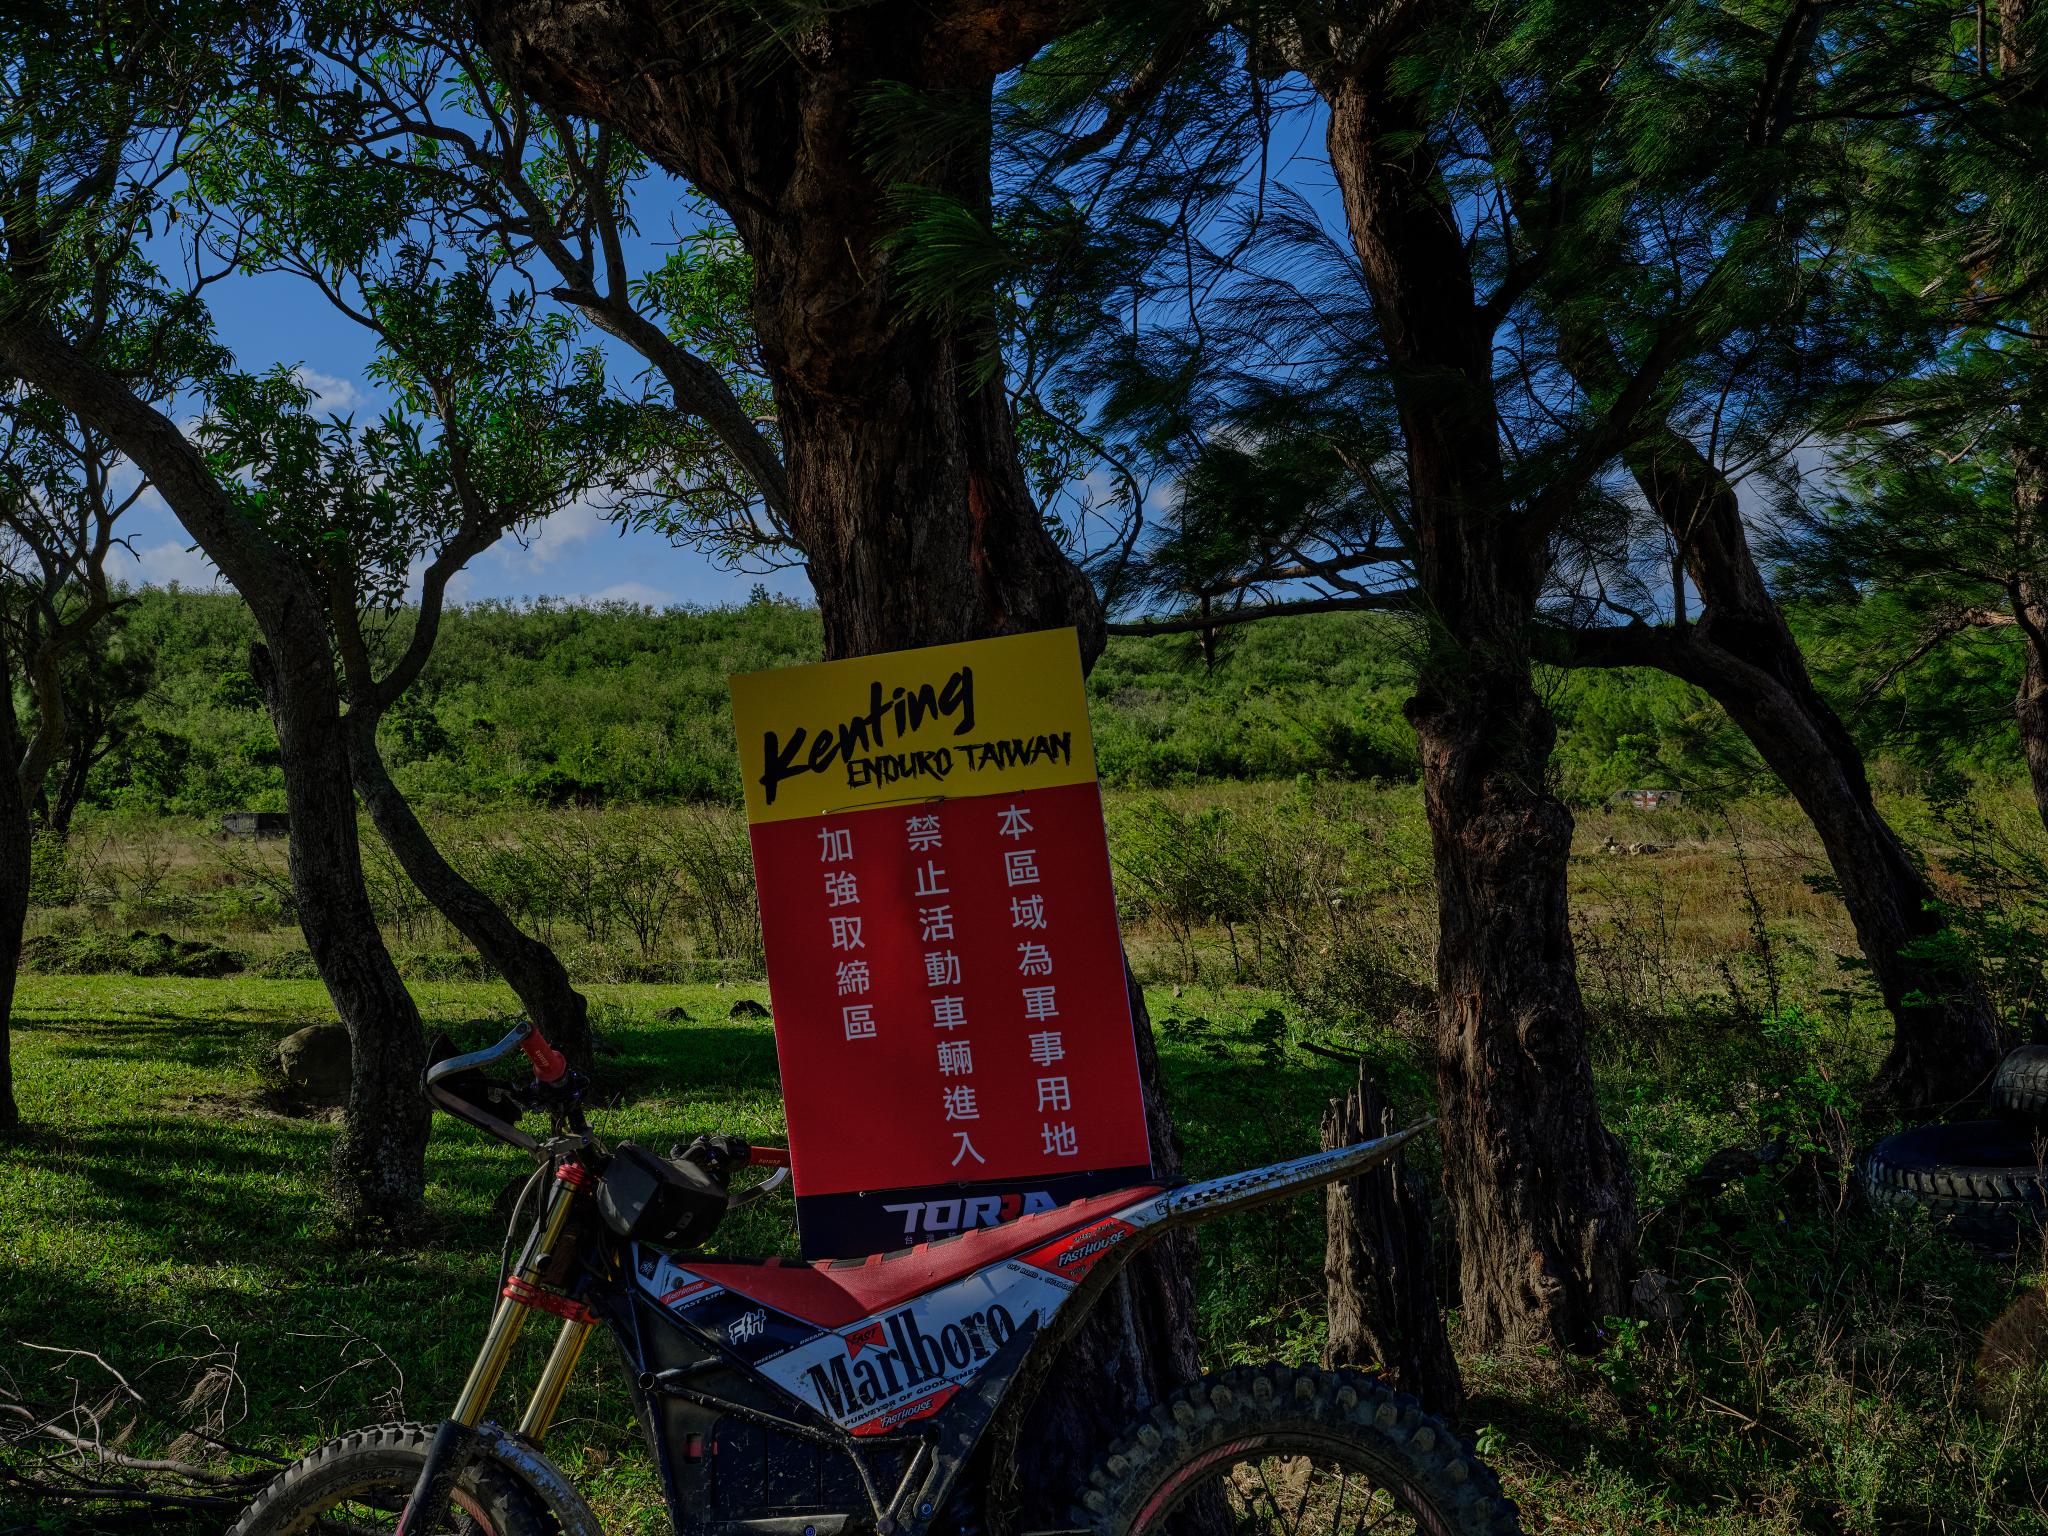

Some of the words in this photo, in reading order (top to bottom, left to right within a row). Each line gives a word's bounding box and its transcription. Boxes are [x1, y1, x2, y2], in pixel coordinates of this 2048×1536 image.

[759, 665, 975, 805] Kenting
[847, 746, 955, 790] ENDURO
[953, 731, 1072, 772] TAIWAN
[816, 826, 878, 1041] 加強取締區
[905, 814, 986, 1168] 禁止活動車輛進入
[996, 803, 1079, 1157] 本區域為軍事用地
[1058, 1229, 1127, 1267] FASTHOUSE
[807, 1304, 1016, 1420] Marlboro
[844, 1400, 896, 1426] PURVEYOR
[899, 1392, 913, 1402] OF
[917, 1380, 946, 1395] GOOD
[881, 1398, 933, 1428] FASTHOUSE
